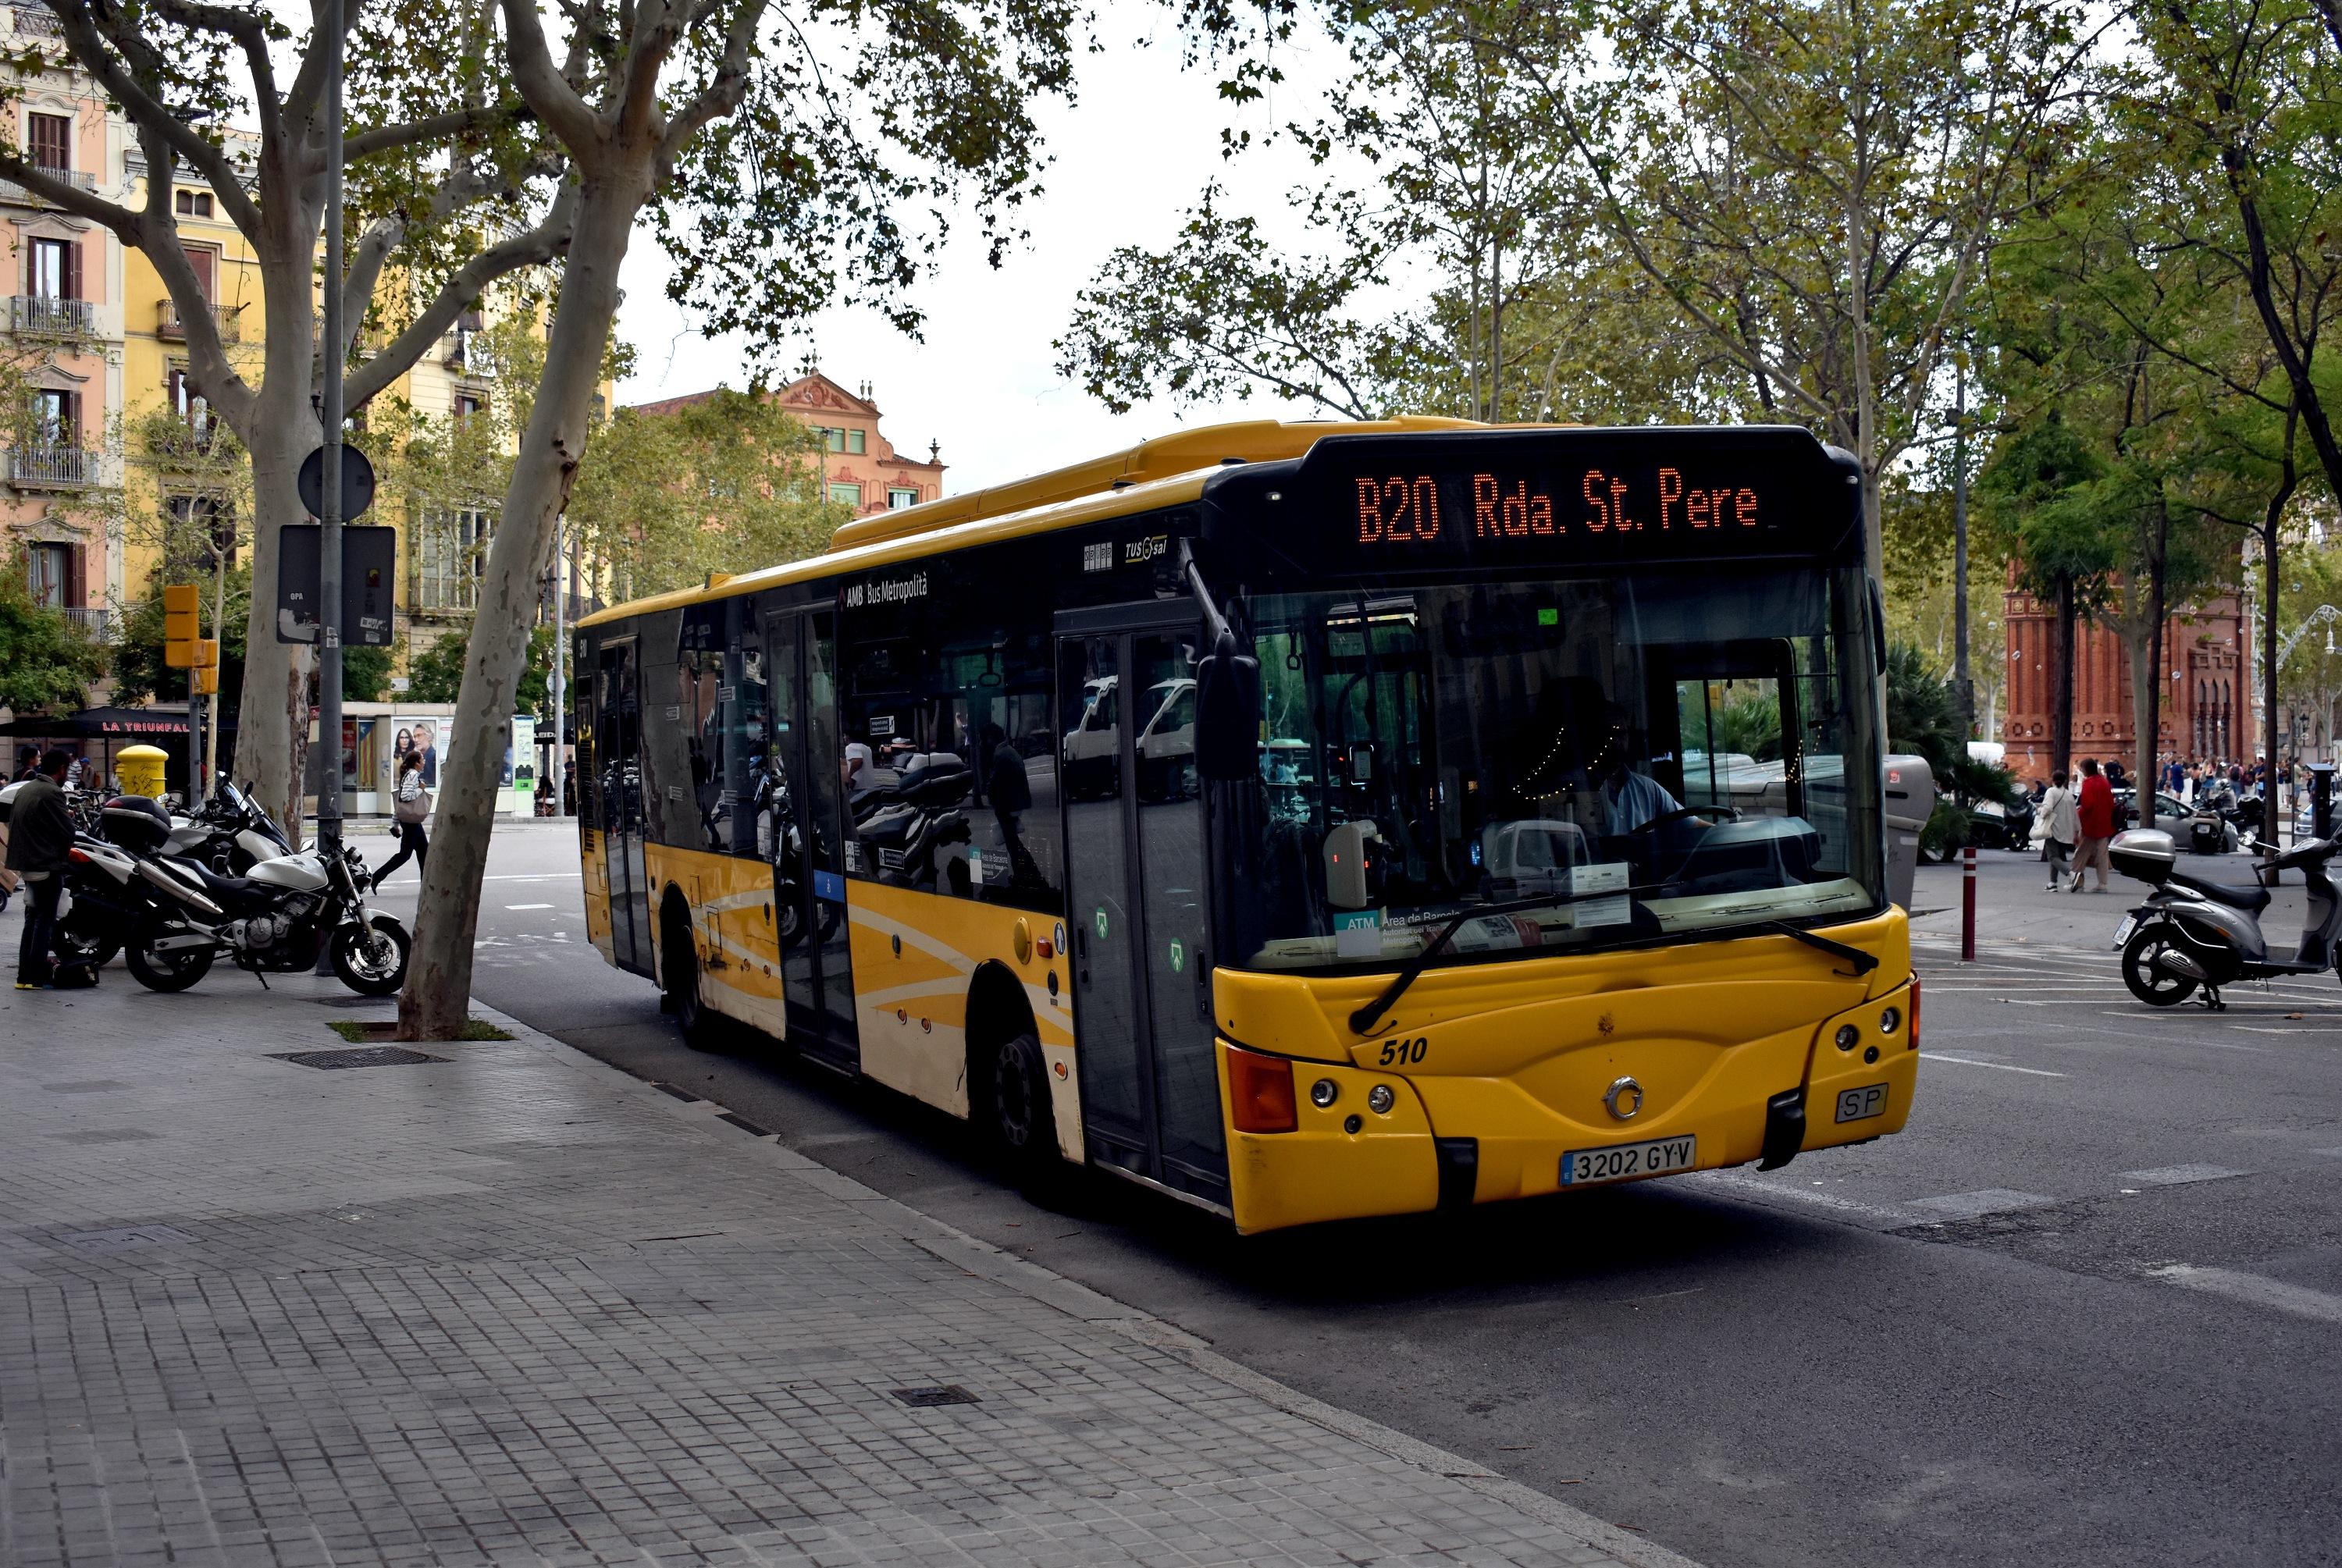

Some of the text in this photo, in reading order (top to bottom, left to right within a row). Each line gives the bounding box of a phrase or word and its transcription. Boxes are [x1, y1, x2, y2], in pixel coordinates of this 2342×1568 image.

[1354, 468, 1757, 542] B20 Rda. St. Pere
[847, 585, 863, 607] AMB
[102, 722, 190, 732] LA TRIUNFAL
[1347, 917, 1375, 930] ATM
[1379, 1037, 1428, 1066] 510
[1844, 1089, 1881, 1117] SP
[1578, 1150, 1638, 1179] 3202
[1647, 1141, 1690, 1170] GYV
